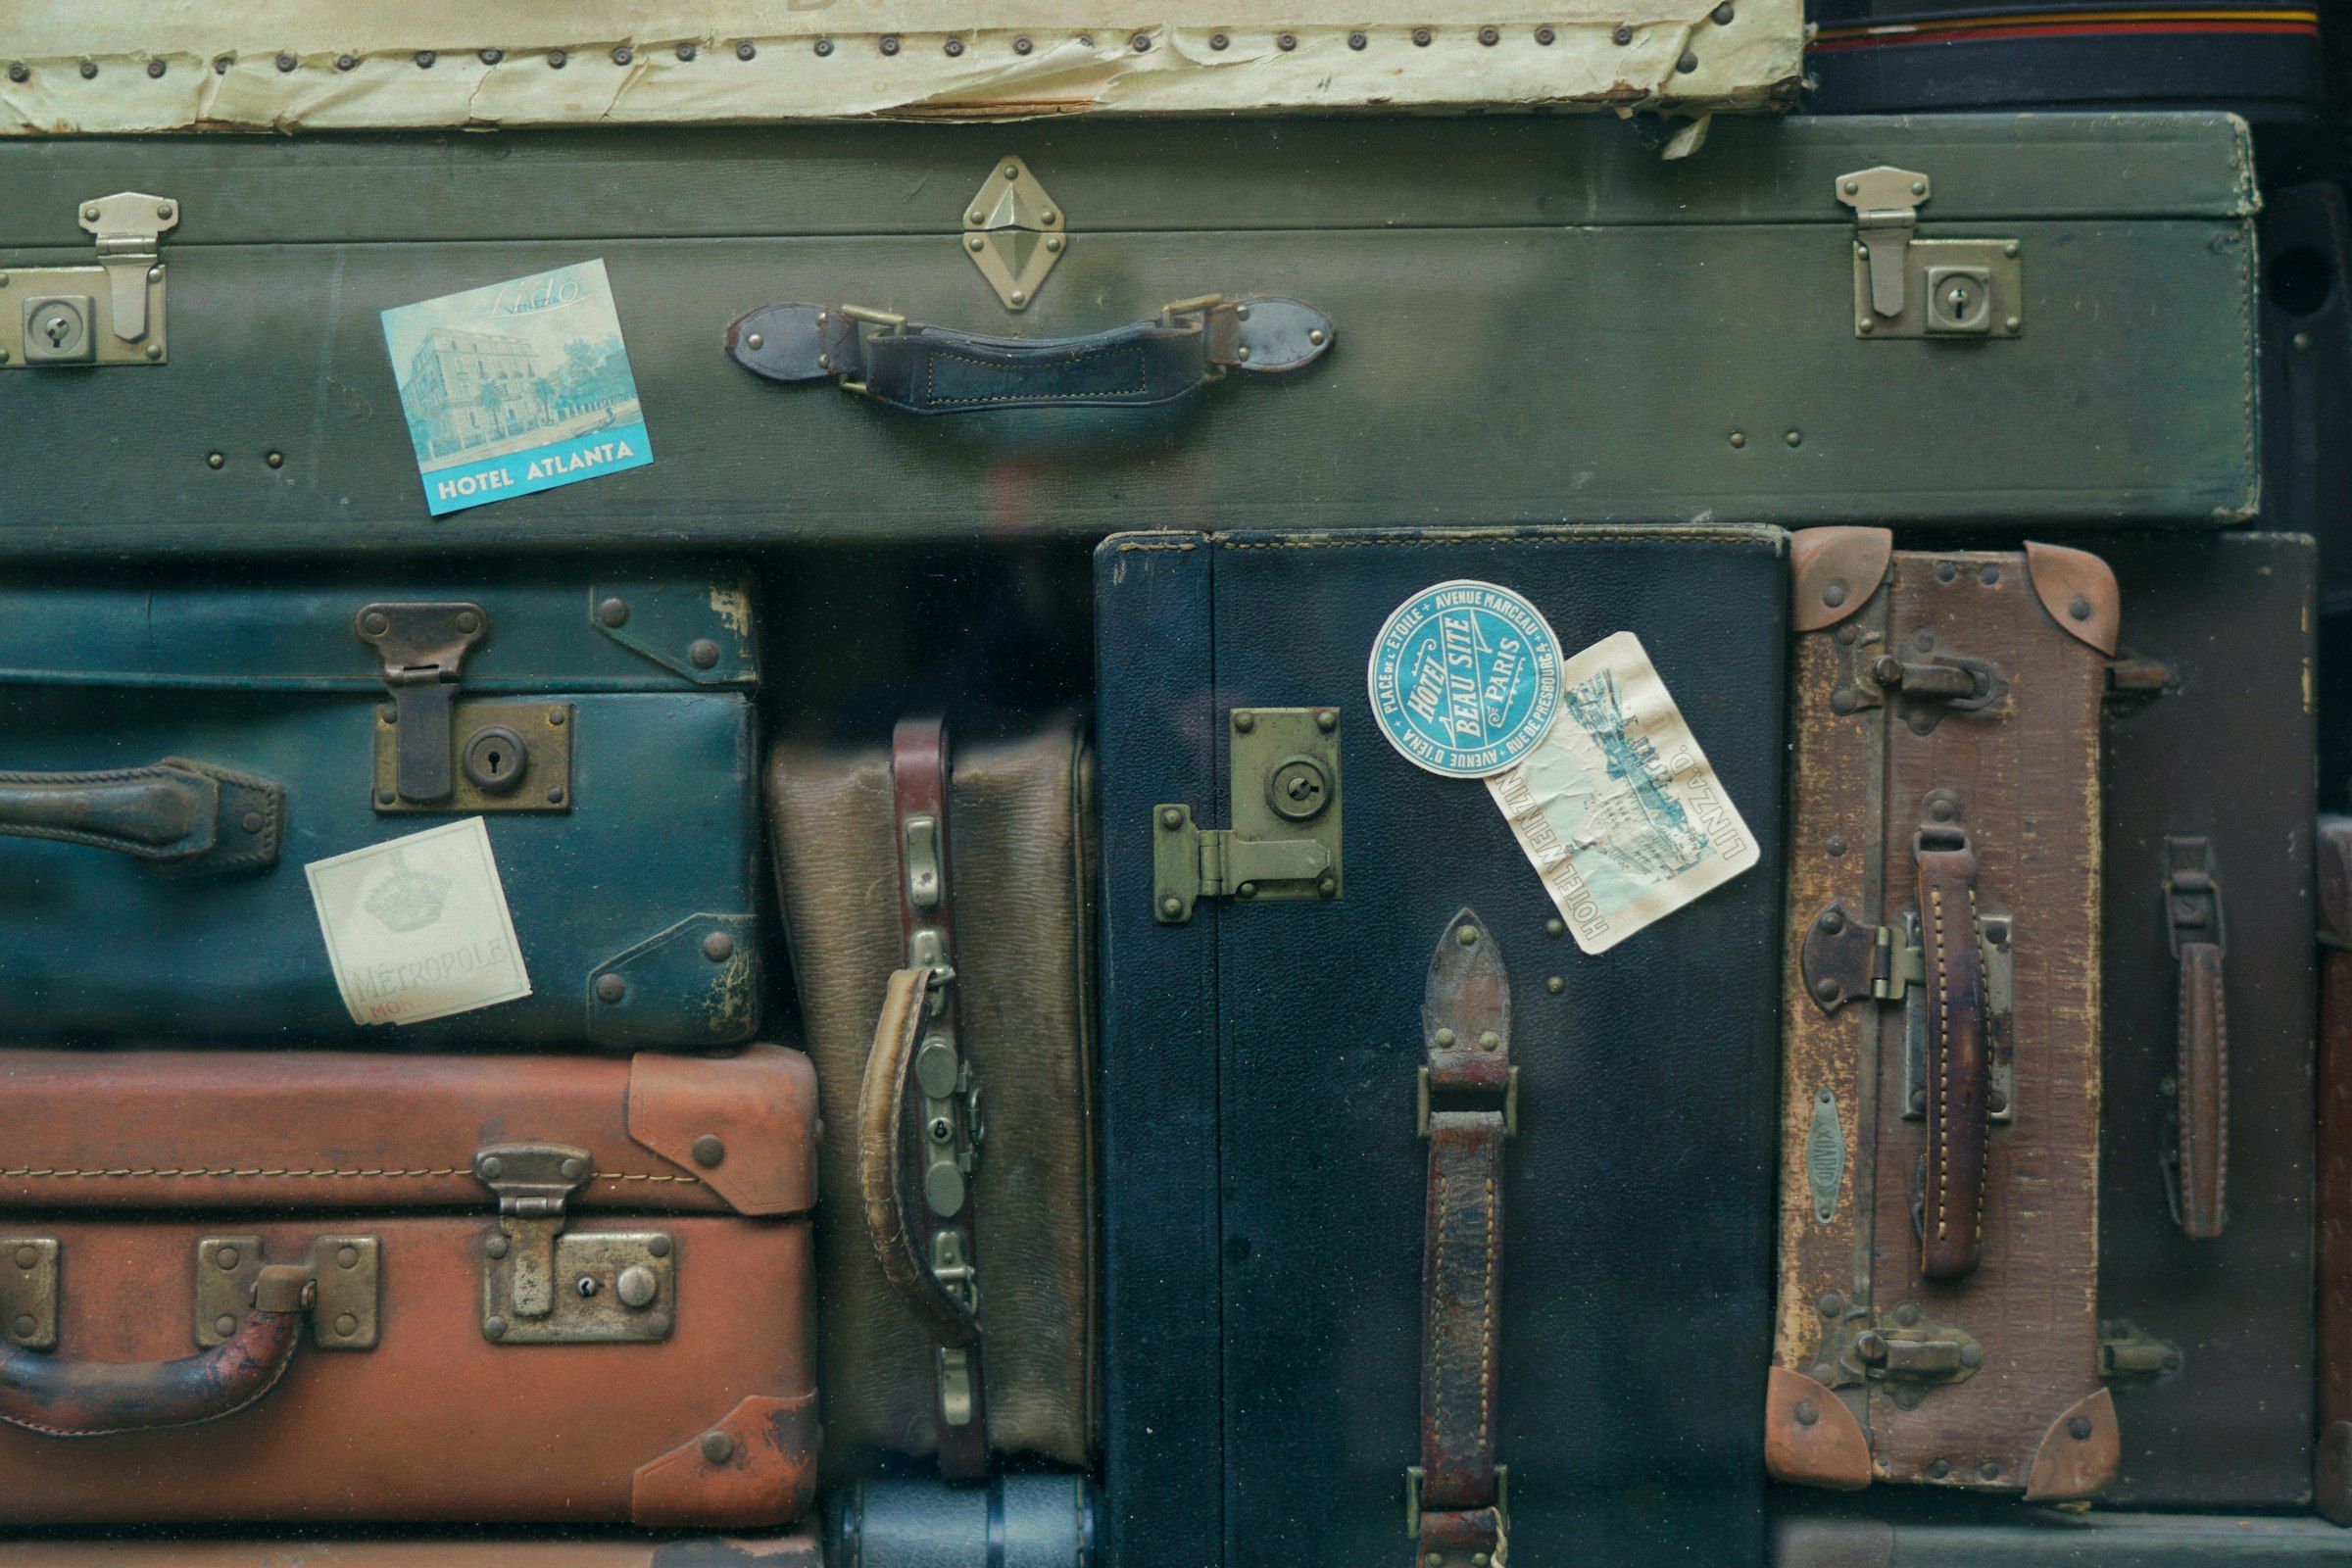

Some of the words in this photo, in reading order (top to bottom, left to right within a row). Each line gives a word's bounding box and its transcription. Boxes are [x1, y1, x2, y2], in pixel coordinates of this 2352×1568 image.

[506, 297, 561, 315] VENEZIA
[438, 467, 514, 501] HOTEL
[527, 440, 634, 481] ATLANTA
[1435, 591, 1482, 610] AVENUE
[1483, 593, 1539, 636] MARCEAU
[1384, 661, 1394, 673] DE
[1445, 617, 1474, 669] SITE
[1378, 674, 1398, 714] PLACE
[1485, 637, 1520, 703] PARIS
[1448, 674, 1481, 738] BEAU
[1449, 750, 1498, 768] AVENUE
[1505, 731, 1531, 755] RUE
[1523, 718, 1542, 738] DE
[1689, 787, 1747, 860] LINZ
[1553, 862, 1609, 941] HOTEL
